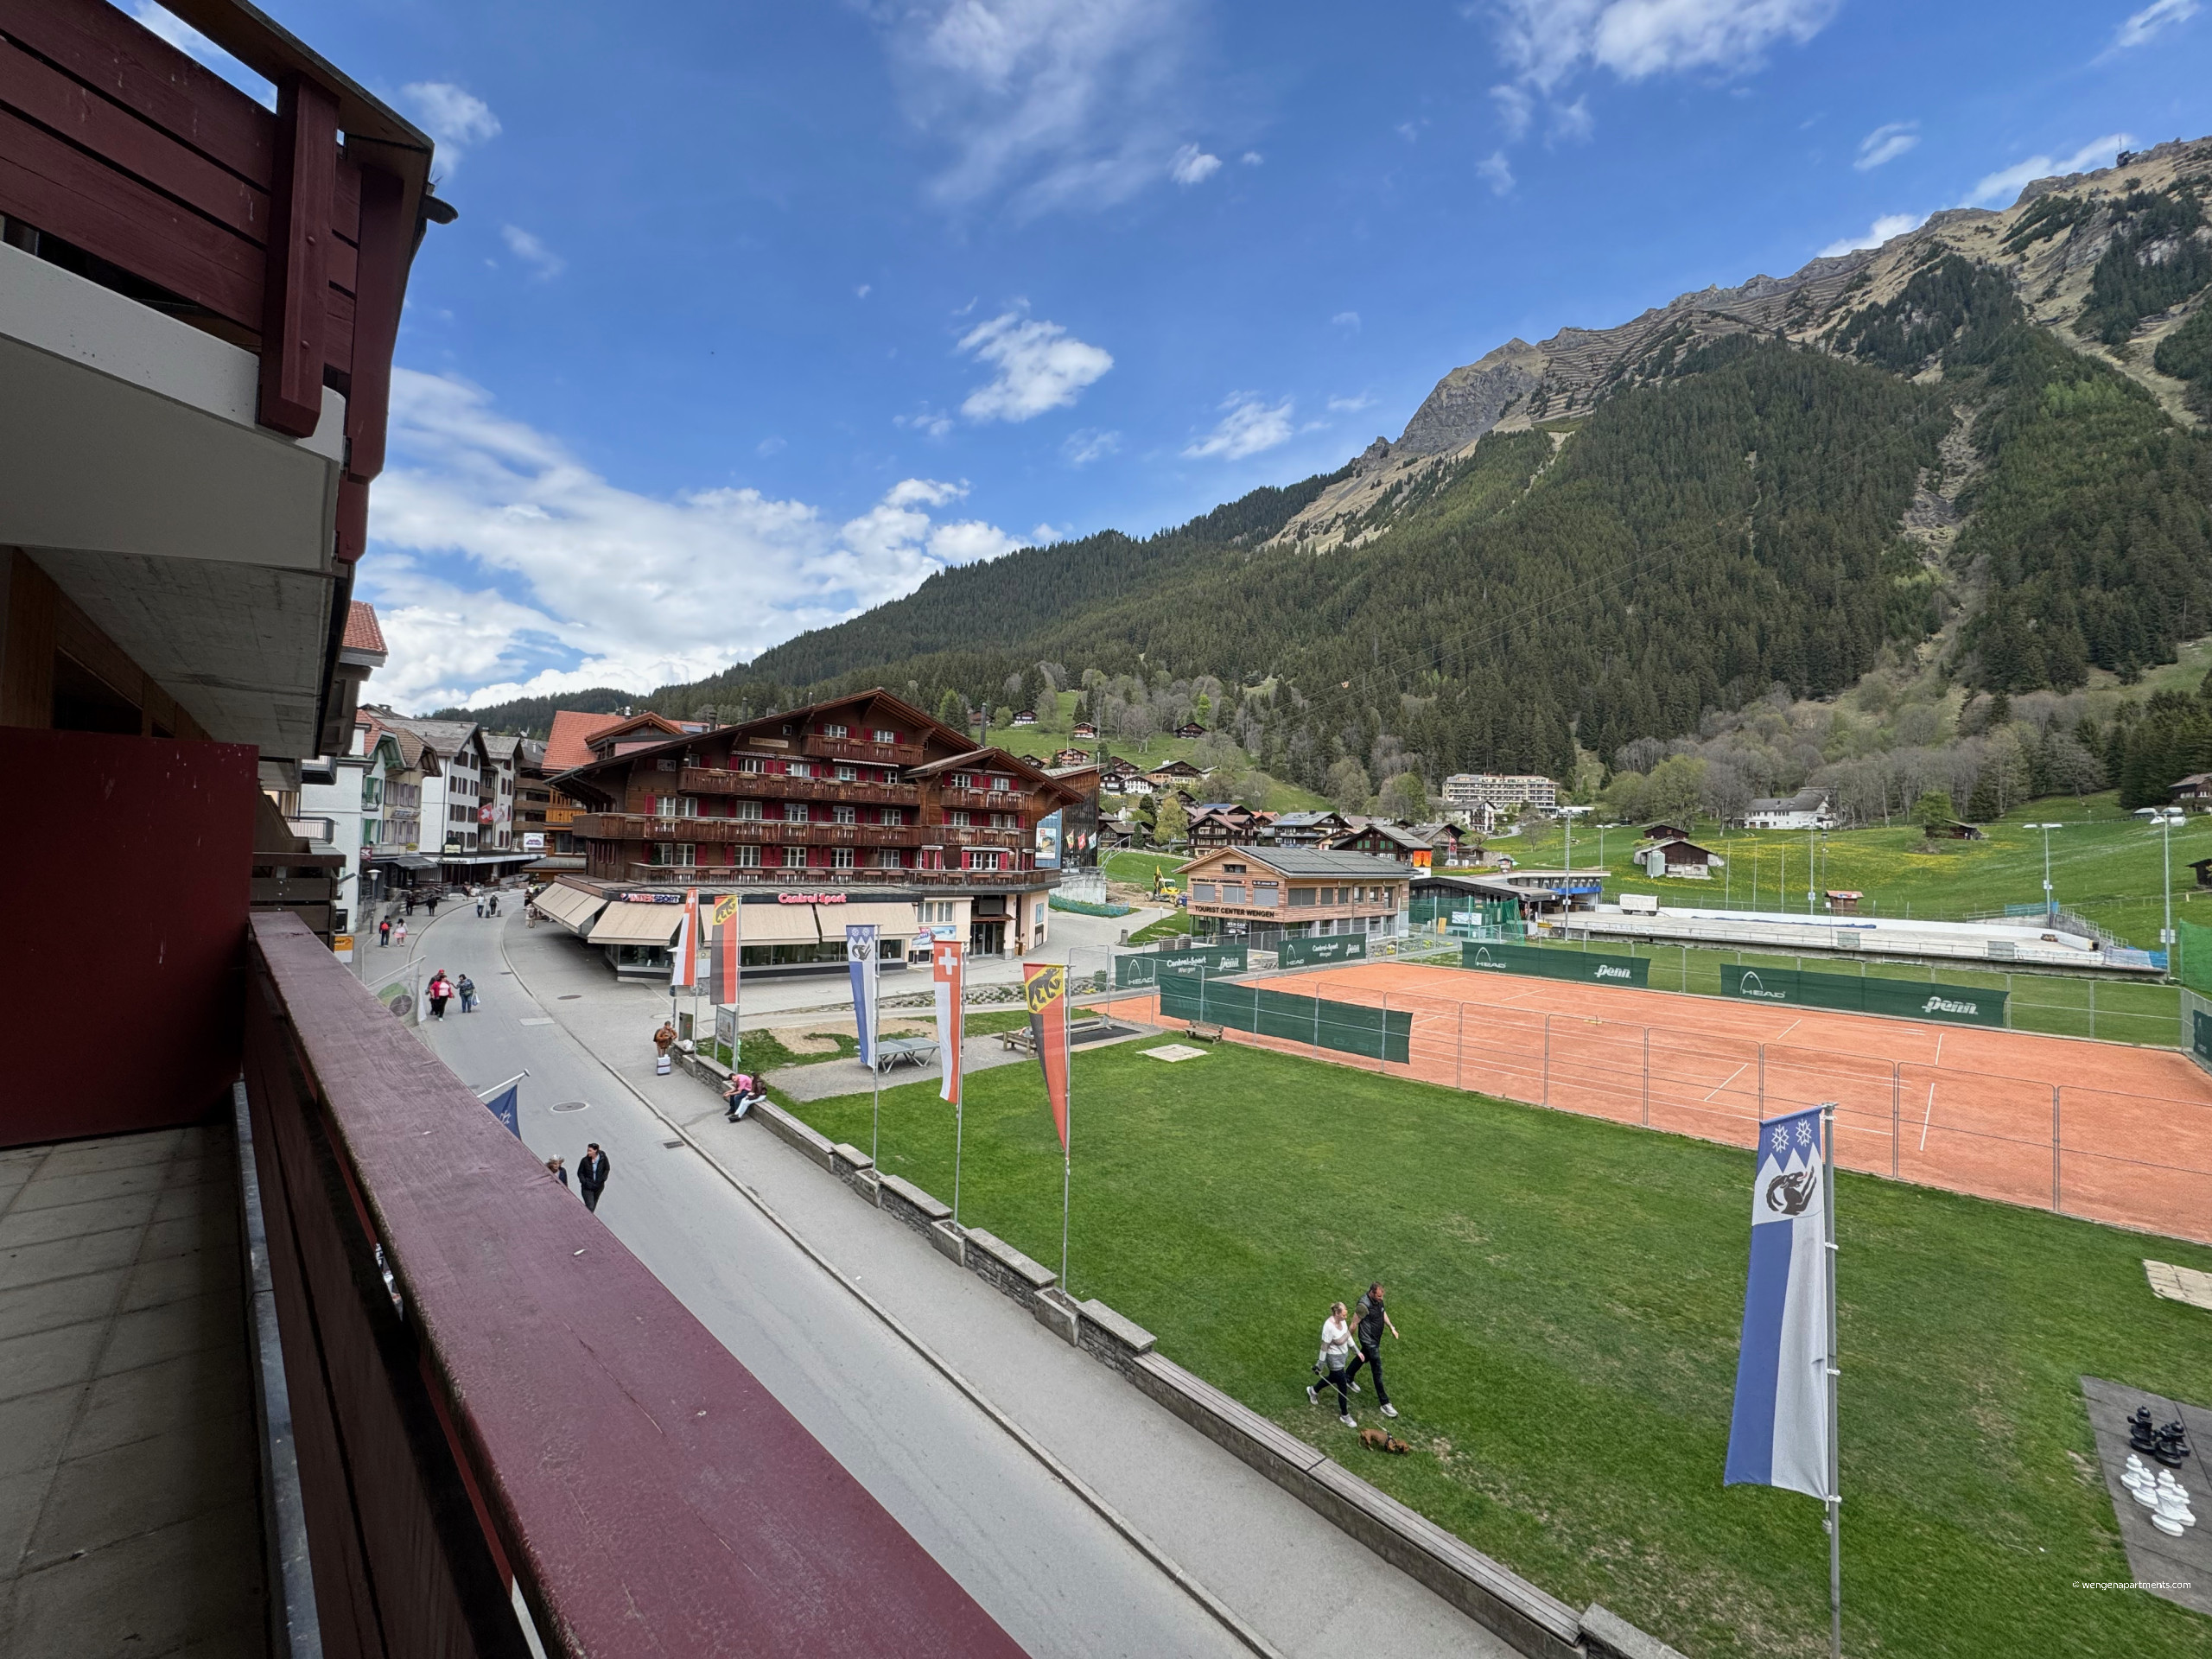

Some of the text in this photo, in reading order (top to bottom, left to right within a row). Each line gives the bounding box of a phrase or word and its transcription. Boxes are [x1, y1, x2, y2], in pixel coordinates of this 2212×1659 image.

[629, 893, 681, 904] INTERSPORT
[778, 893, 847, 906] Central Sport
[1742, 988, 1785, 999] HEAD
